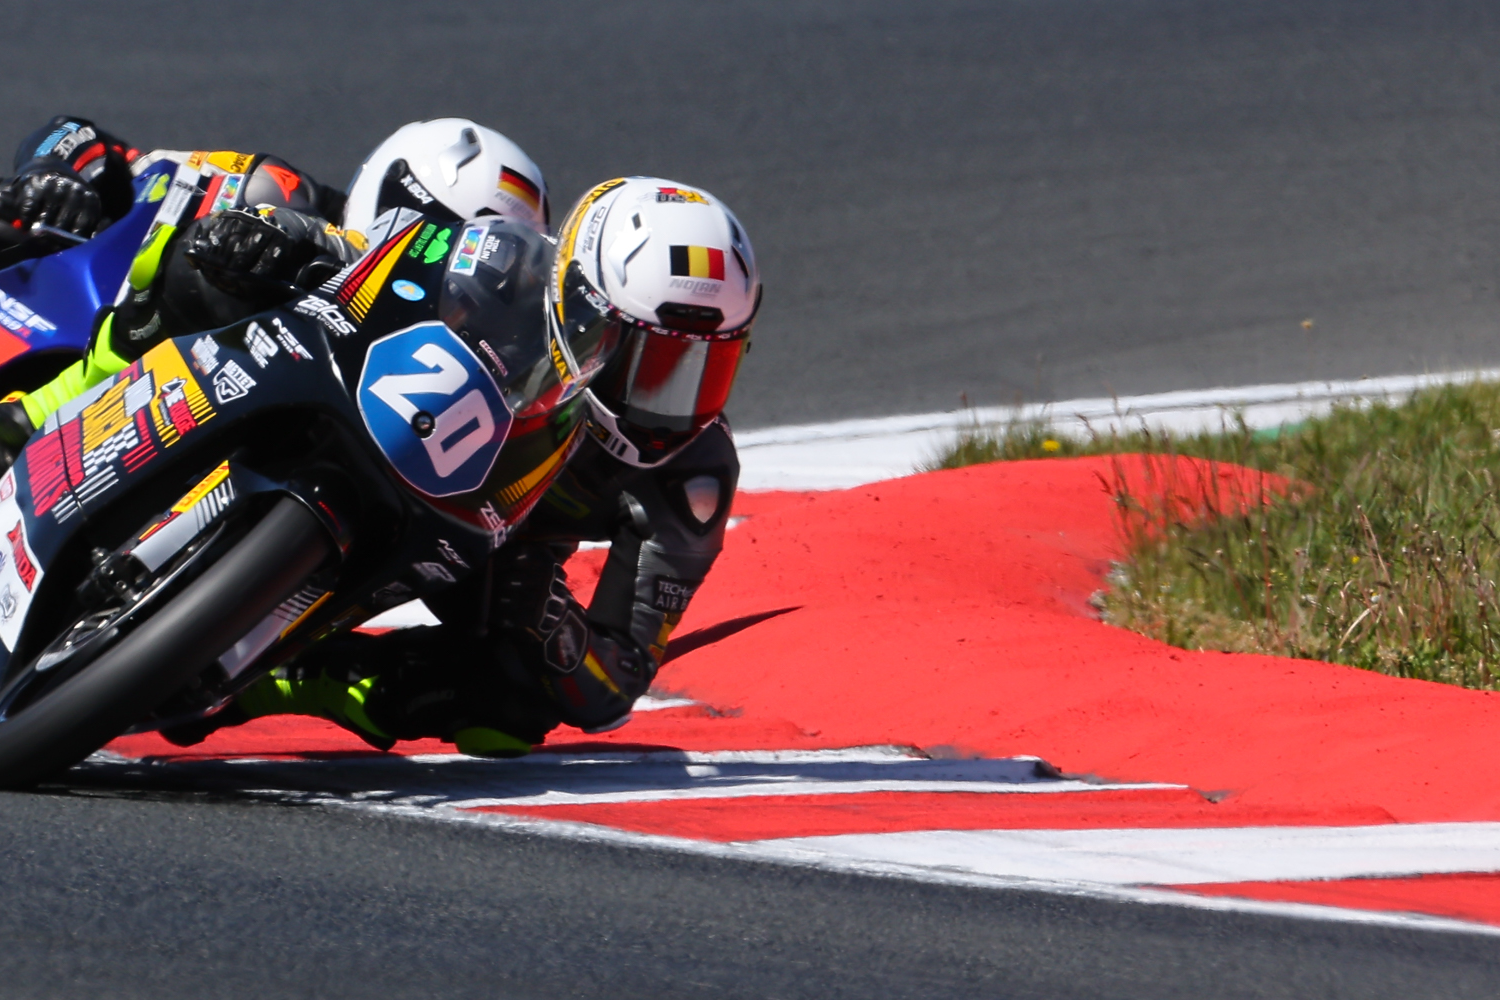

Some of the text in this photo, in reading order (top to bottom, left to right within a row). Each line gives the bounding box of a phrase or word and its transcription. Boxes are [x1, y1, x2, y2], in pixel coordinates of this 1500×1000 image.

[668, 278, 723, 298] NOLAN
[272, 317, 314, 361] NSF
[224, 359, 257, 390] METTET
[368, 342, 496, 480] 20
